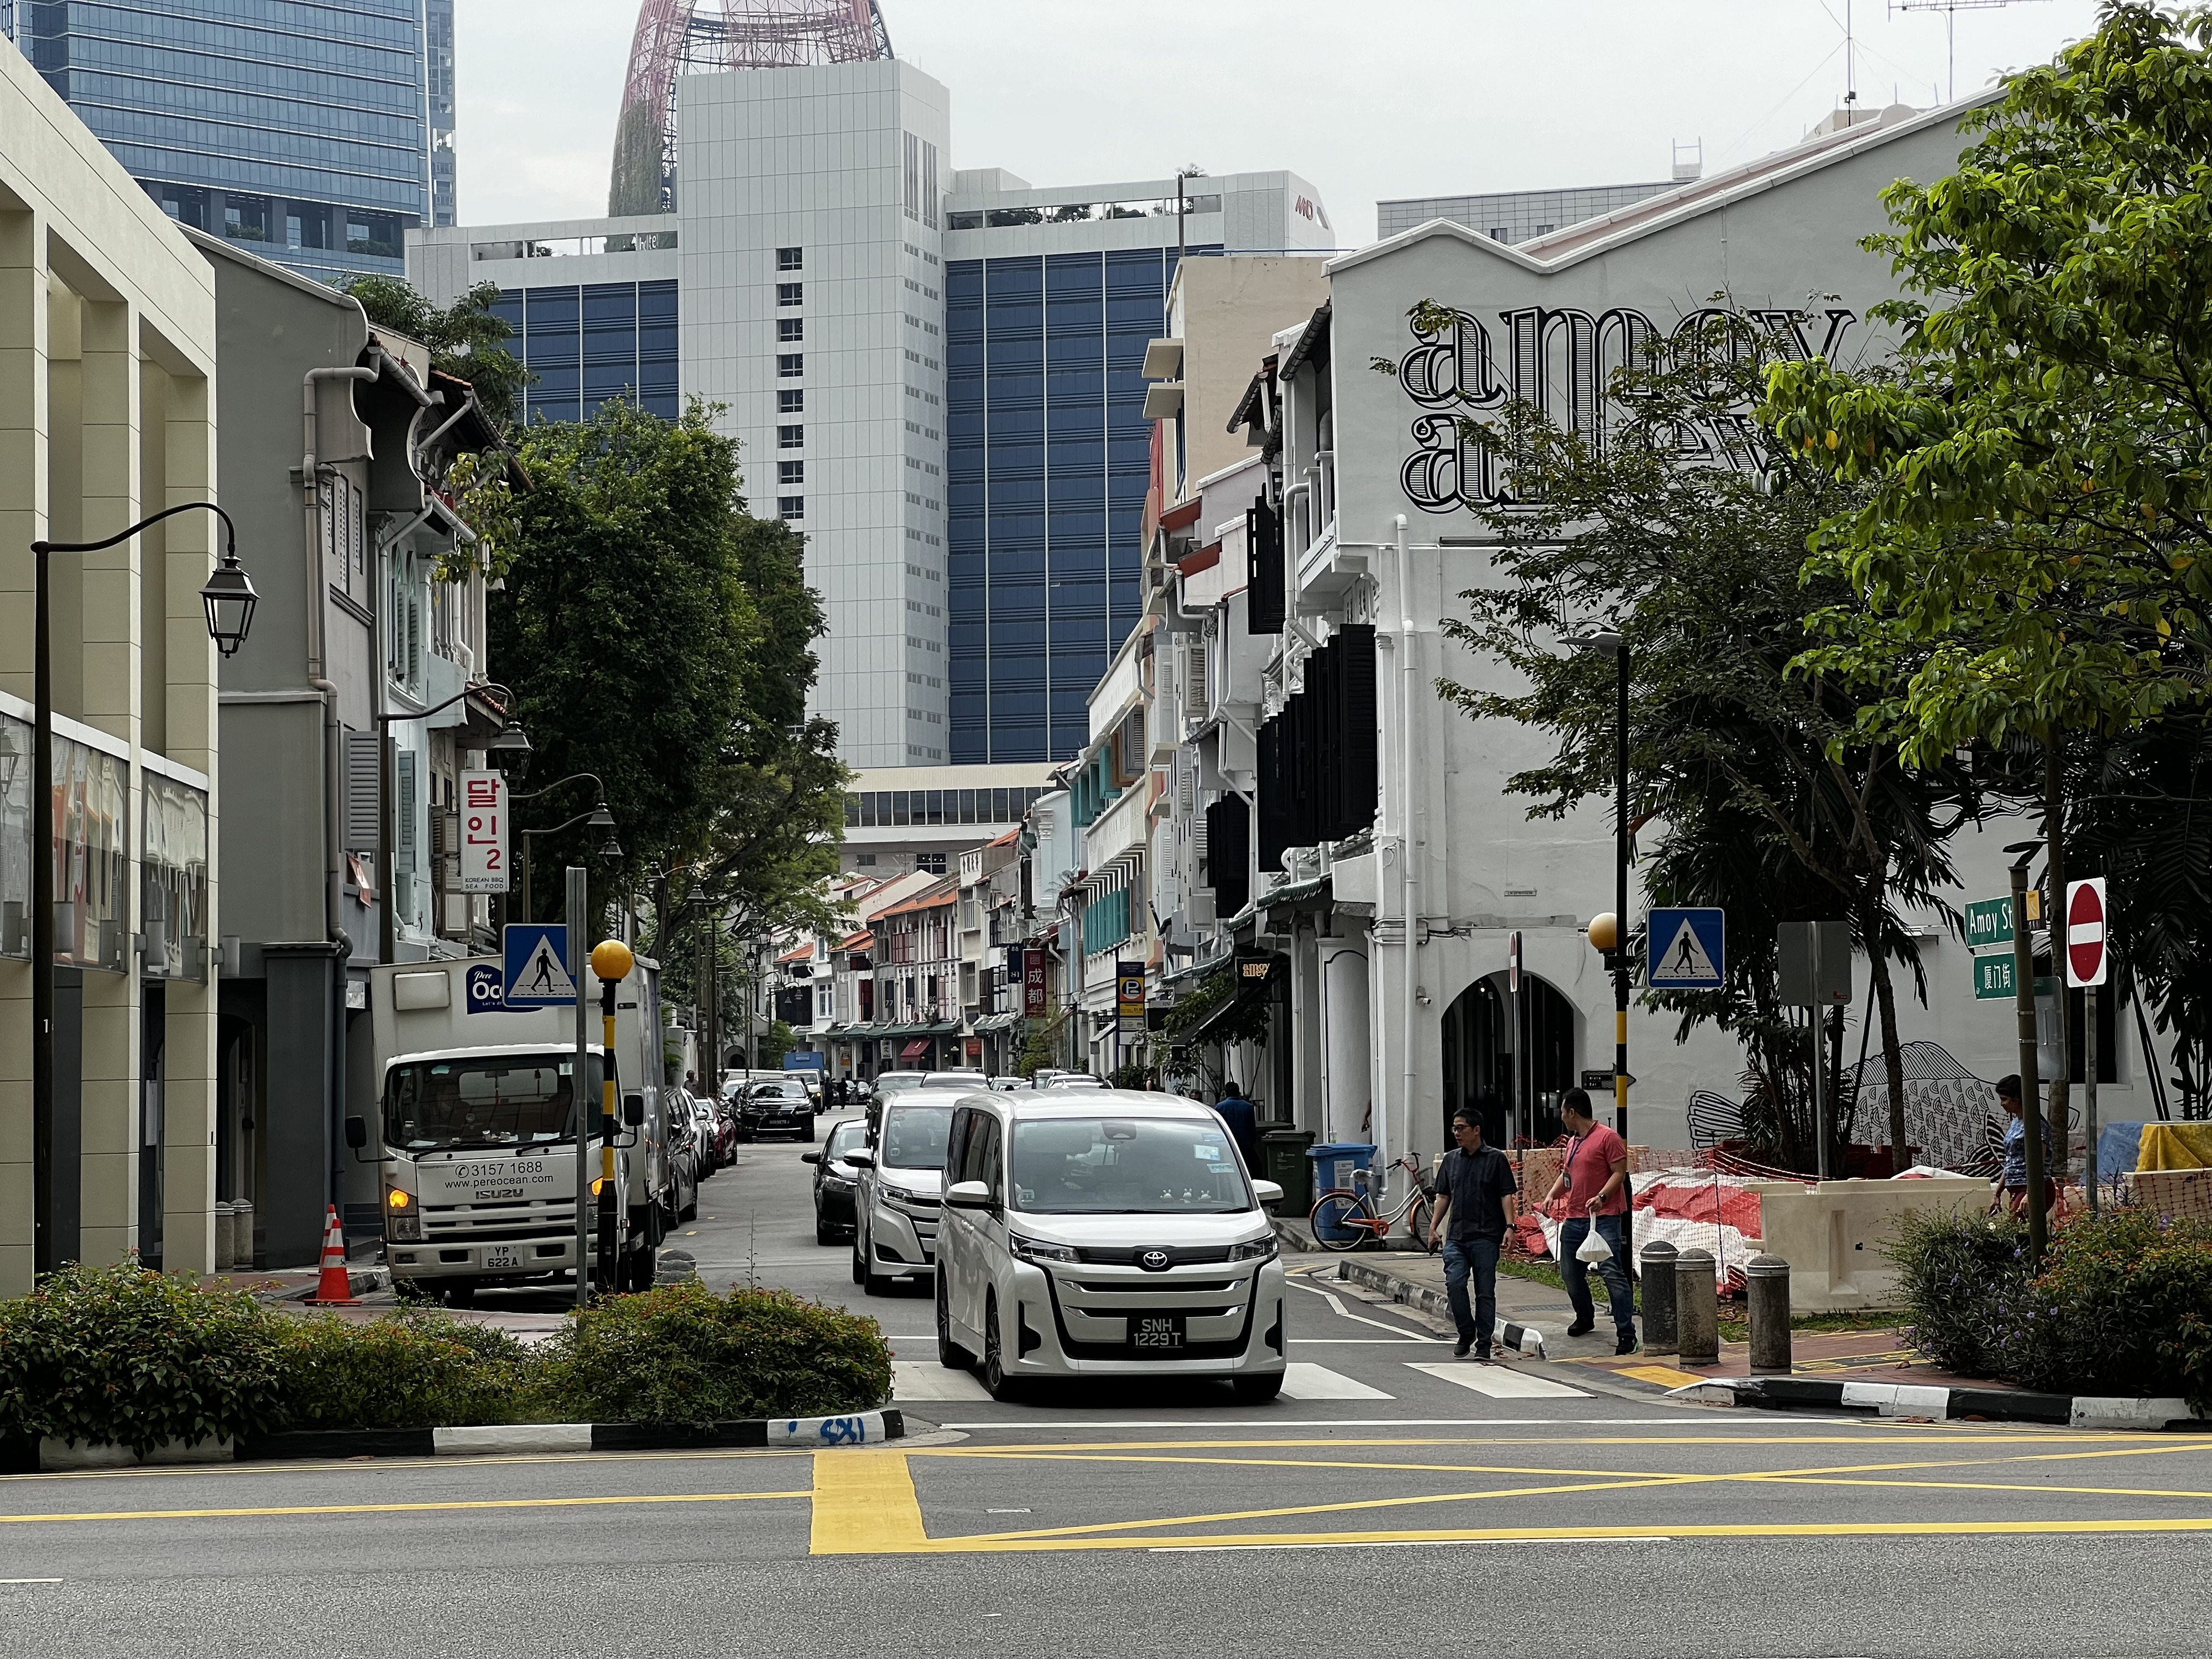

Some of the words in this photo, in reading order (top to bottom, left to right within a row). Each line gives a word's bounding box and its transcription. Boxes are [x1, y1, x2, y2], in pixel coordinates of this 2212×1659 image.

[1970, 908, 1997, 938] Amoy
[2001, 903, 2013, 930] St
[1984, 963, 2011, 989] 厦门街
[472, 981, 502, 1000] Oc
[1027, 968, 1044, 1004] 成都
[471, 1163, 504, 1177] 3157
[510, 1161, 542, 1174] 1688
[445, 1175, 554, 1188] www.pereocean.com
[476, 1188, 524, 1199] ISUZU
[494, 1246, 509, 1256] YP
[1141, 1318, 1172, 1332] SNH
